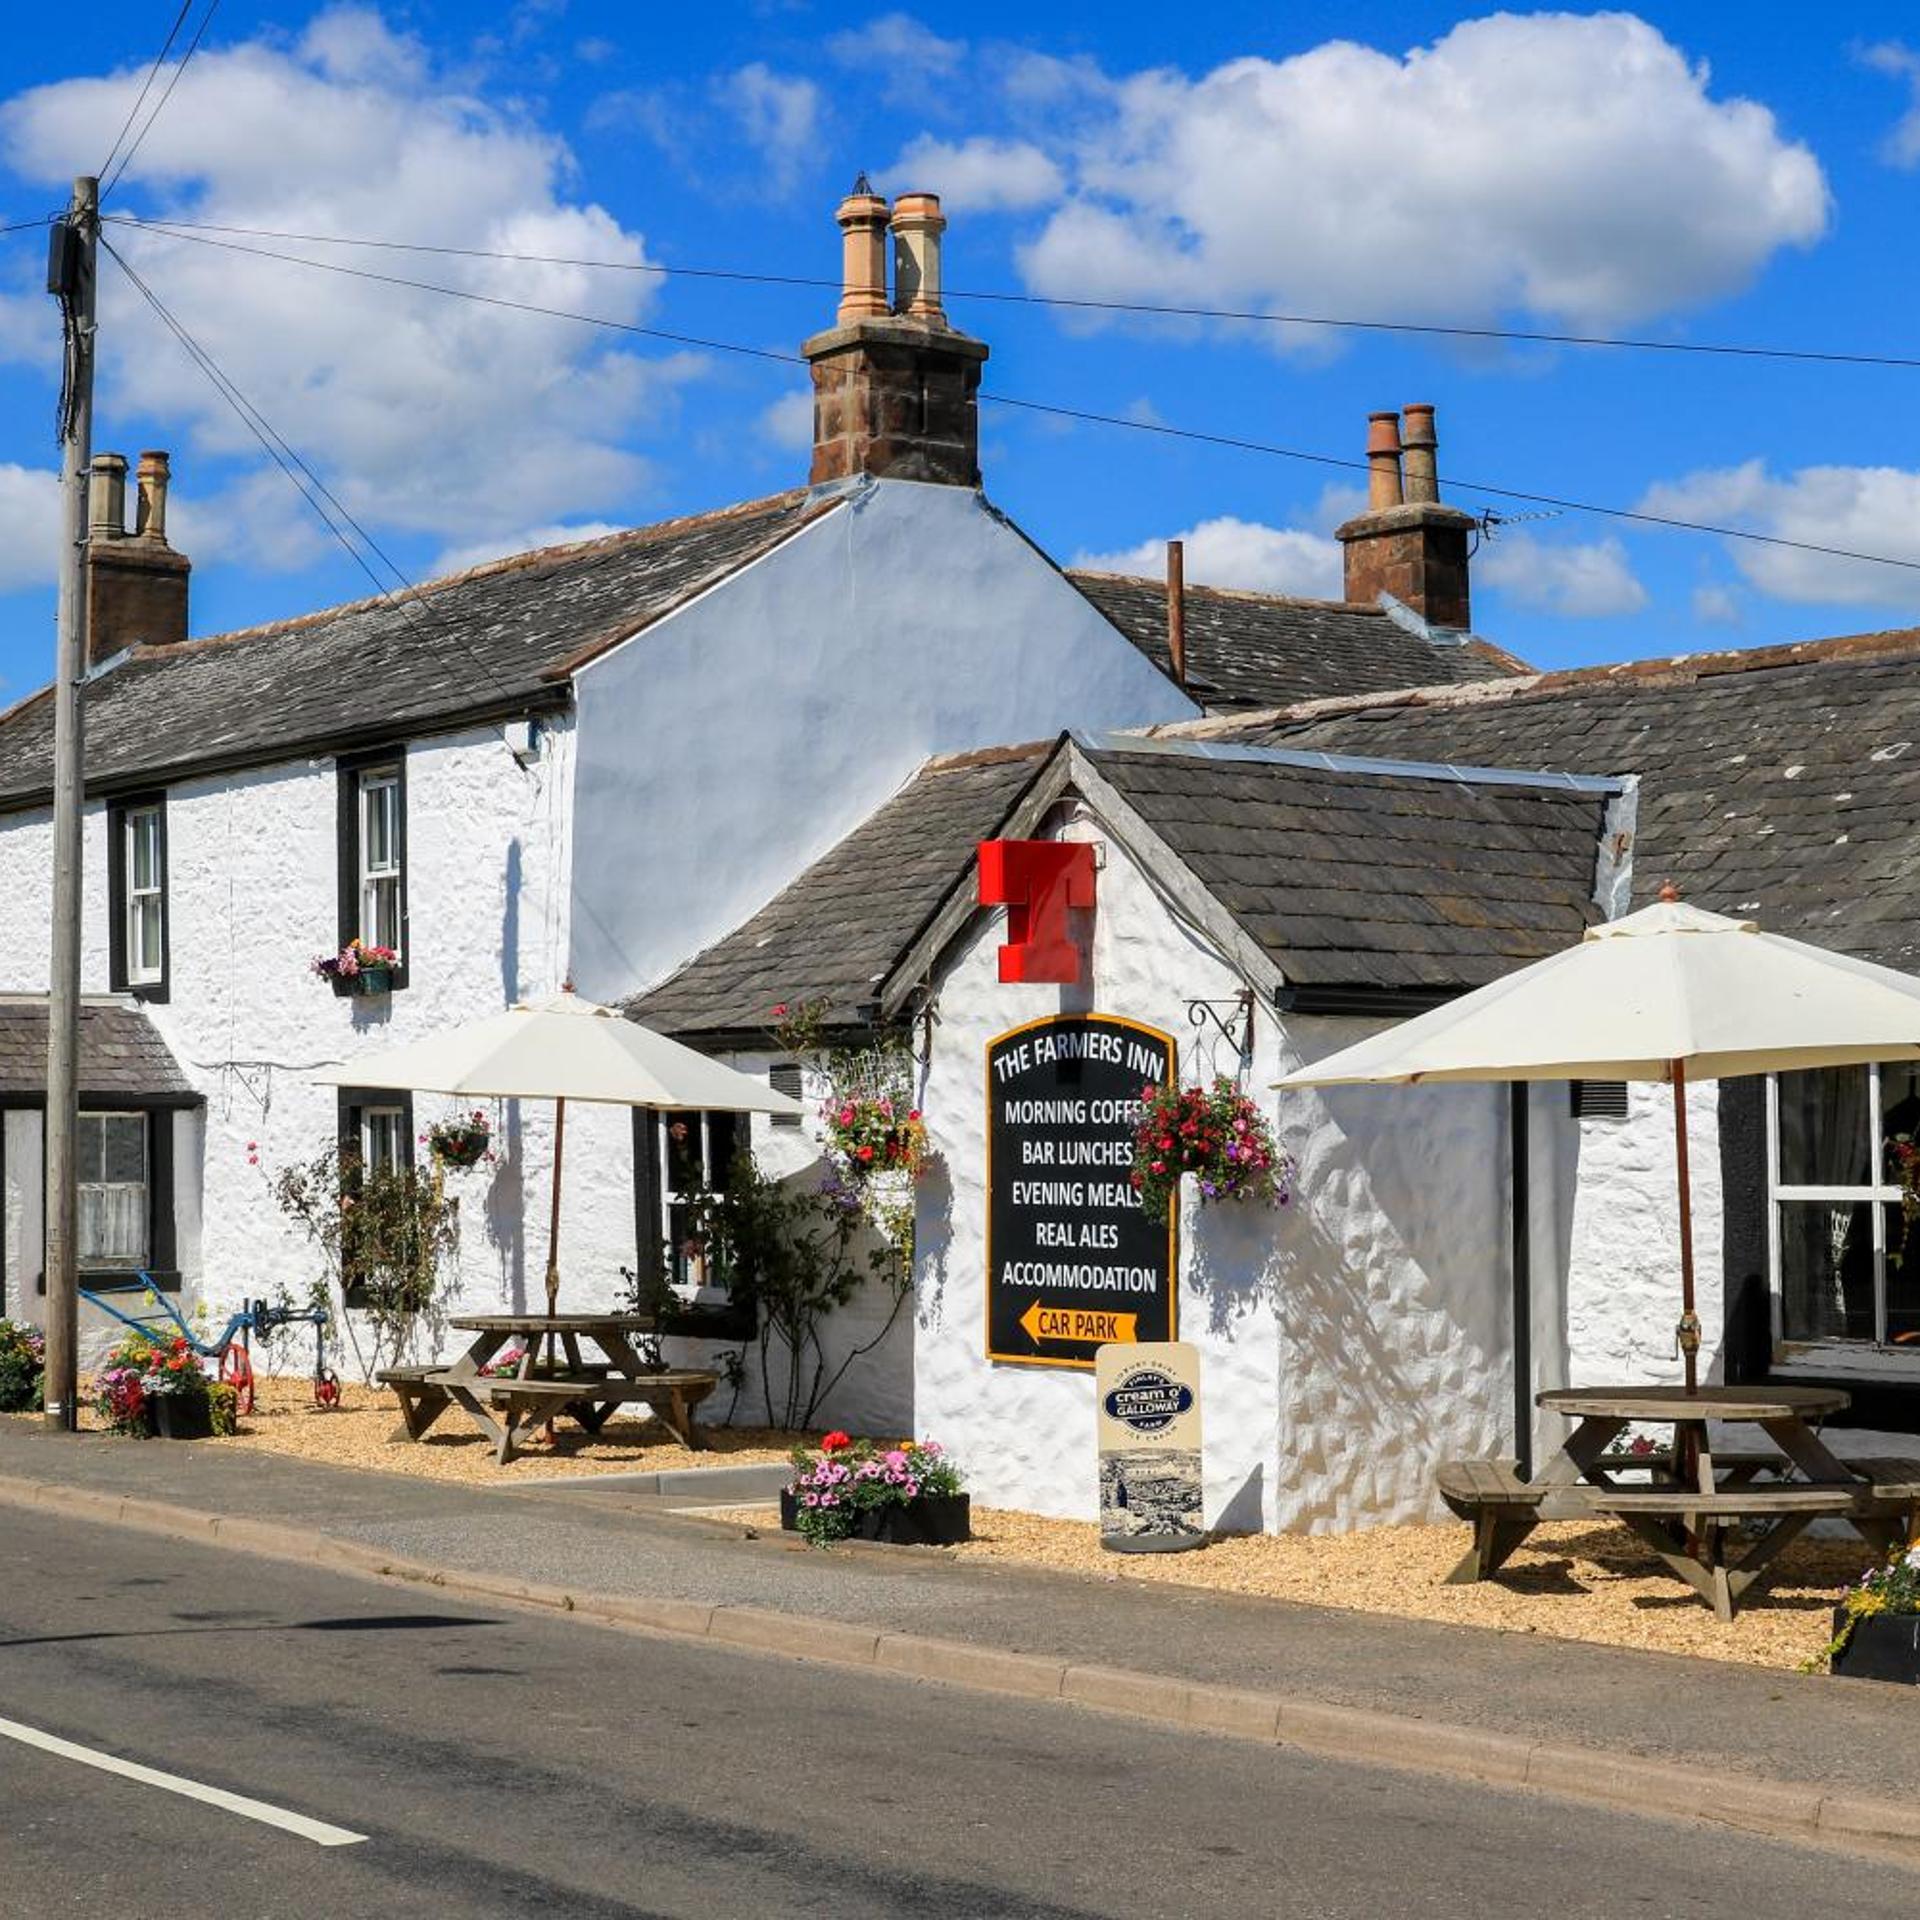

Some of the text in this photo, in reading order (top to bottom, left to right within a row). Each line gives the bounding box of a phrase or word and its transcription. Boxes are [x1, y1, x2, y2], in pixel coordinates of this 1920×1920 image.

[994, 1032, 1165, 1083] THE FARMERS INN
[1005, 1100, 1086, 1124] MORNING
[1022, 1142, 1134, 1166] BAR LUNCHES
[1012, 1181, 1084, 1206] EVENING
[1036, 1223, 1119, 1248] REAL ALES
[1001, 1261, 1157, 1293] ACCOMMODATION
[1037, 1311, 1118, 1339] CAR PARK
[1115, 1389, 1165, 1403] cream
[1116, 1400, 1180, 1416] GALLOWAY
